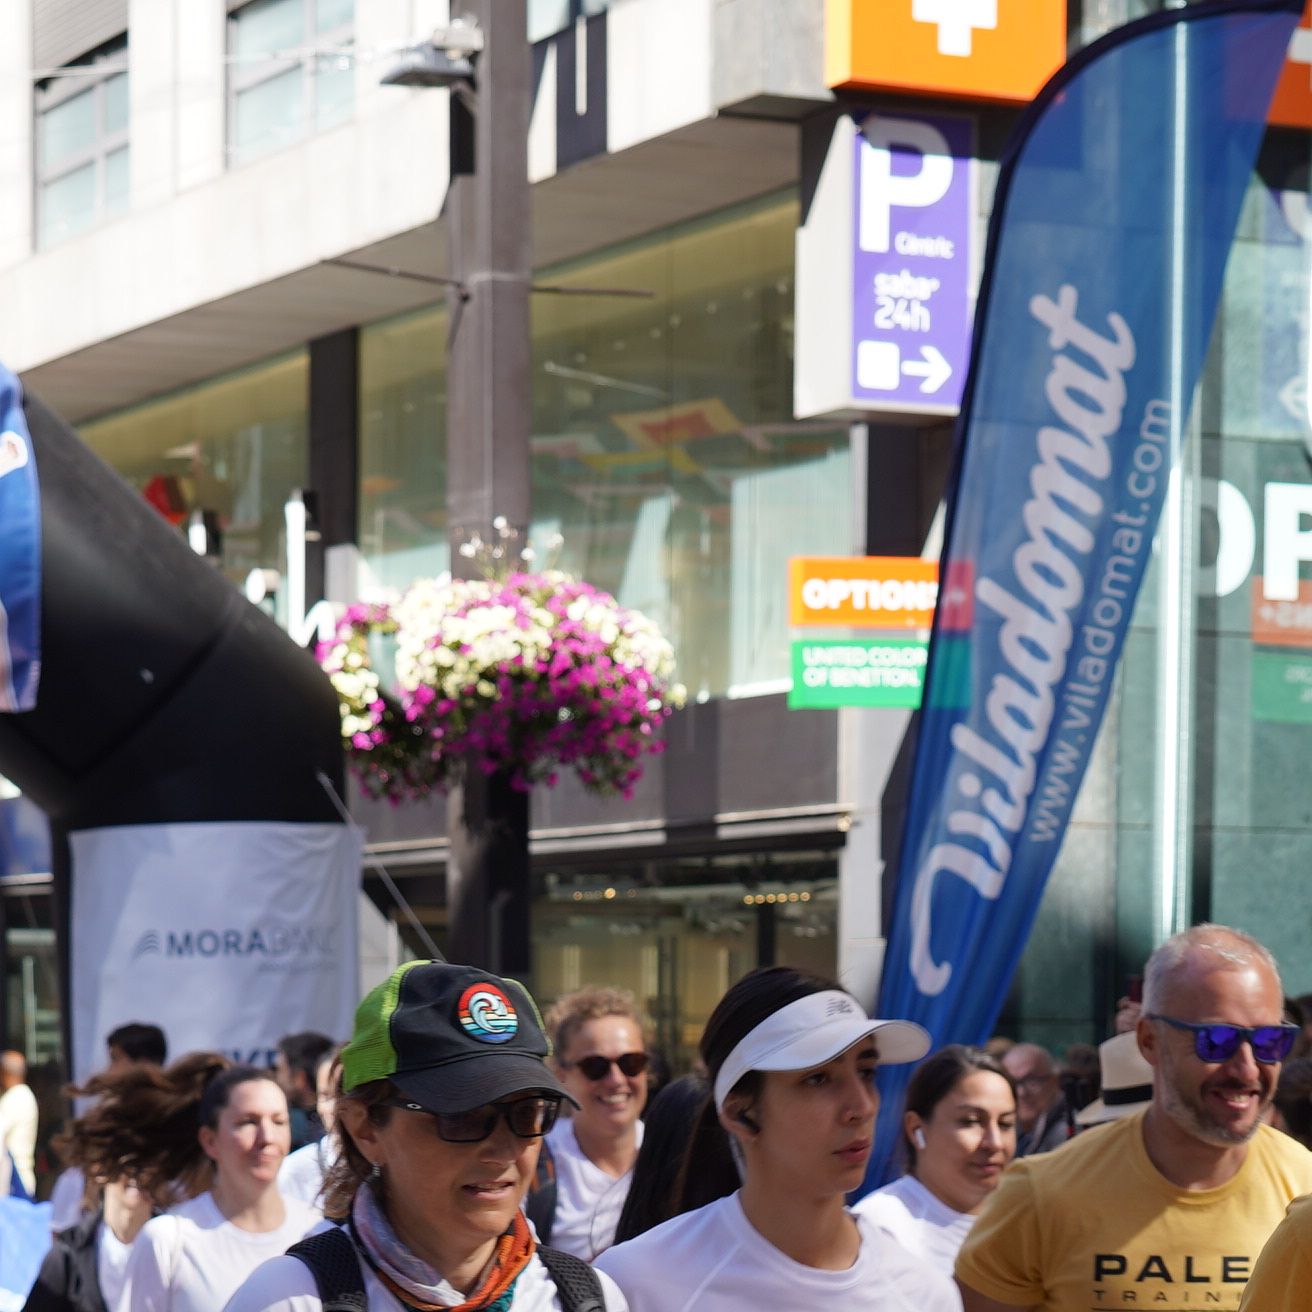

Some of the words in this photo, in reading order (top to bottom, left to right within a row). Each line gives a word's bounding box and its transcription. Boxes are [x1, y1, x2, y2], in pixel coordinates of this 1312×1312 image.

[859, 116, 955, 254] P
[874, 297, 930, 332] 24h
[1093, 1253, 1251, 1284] PALE
